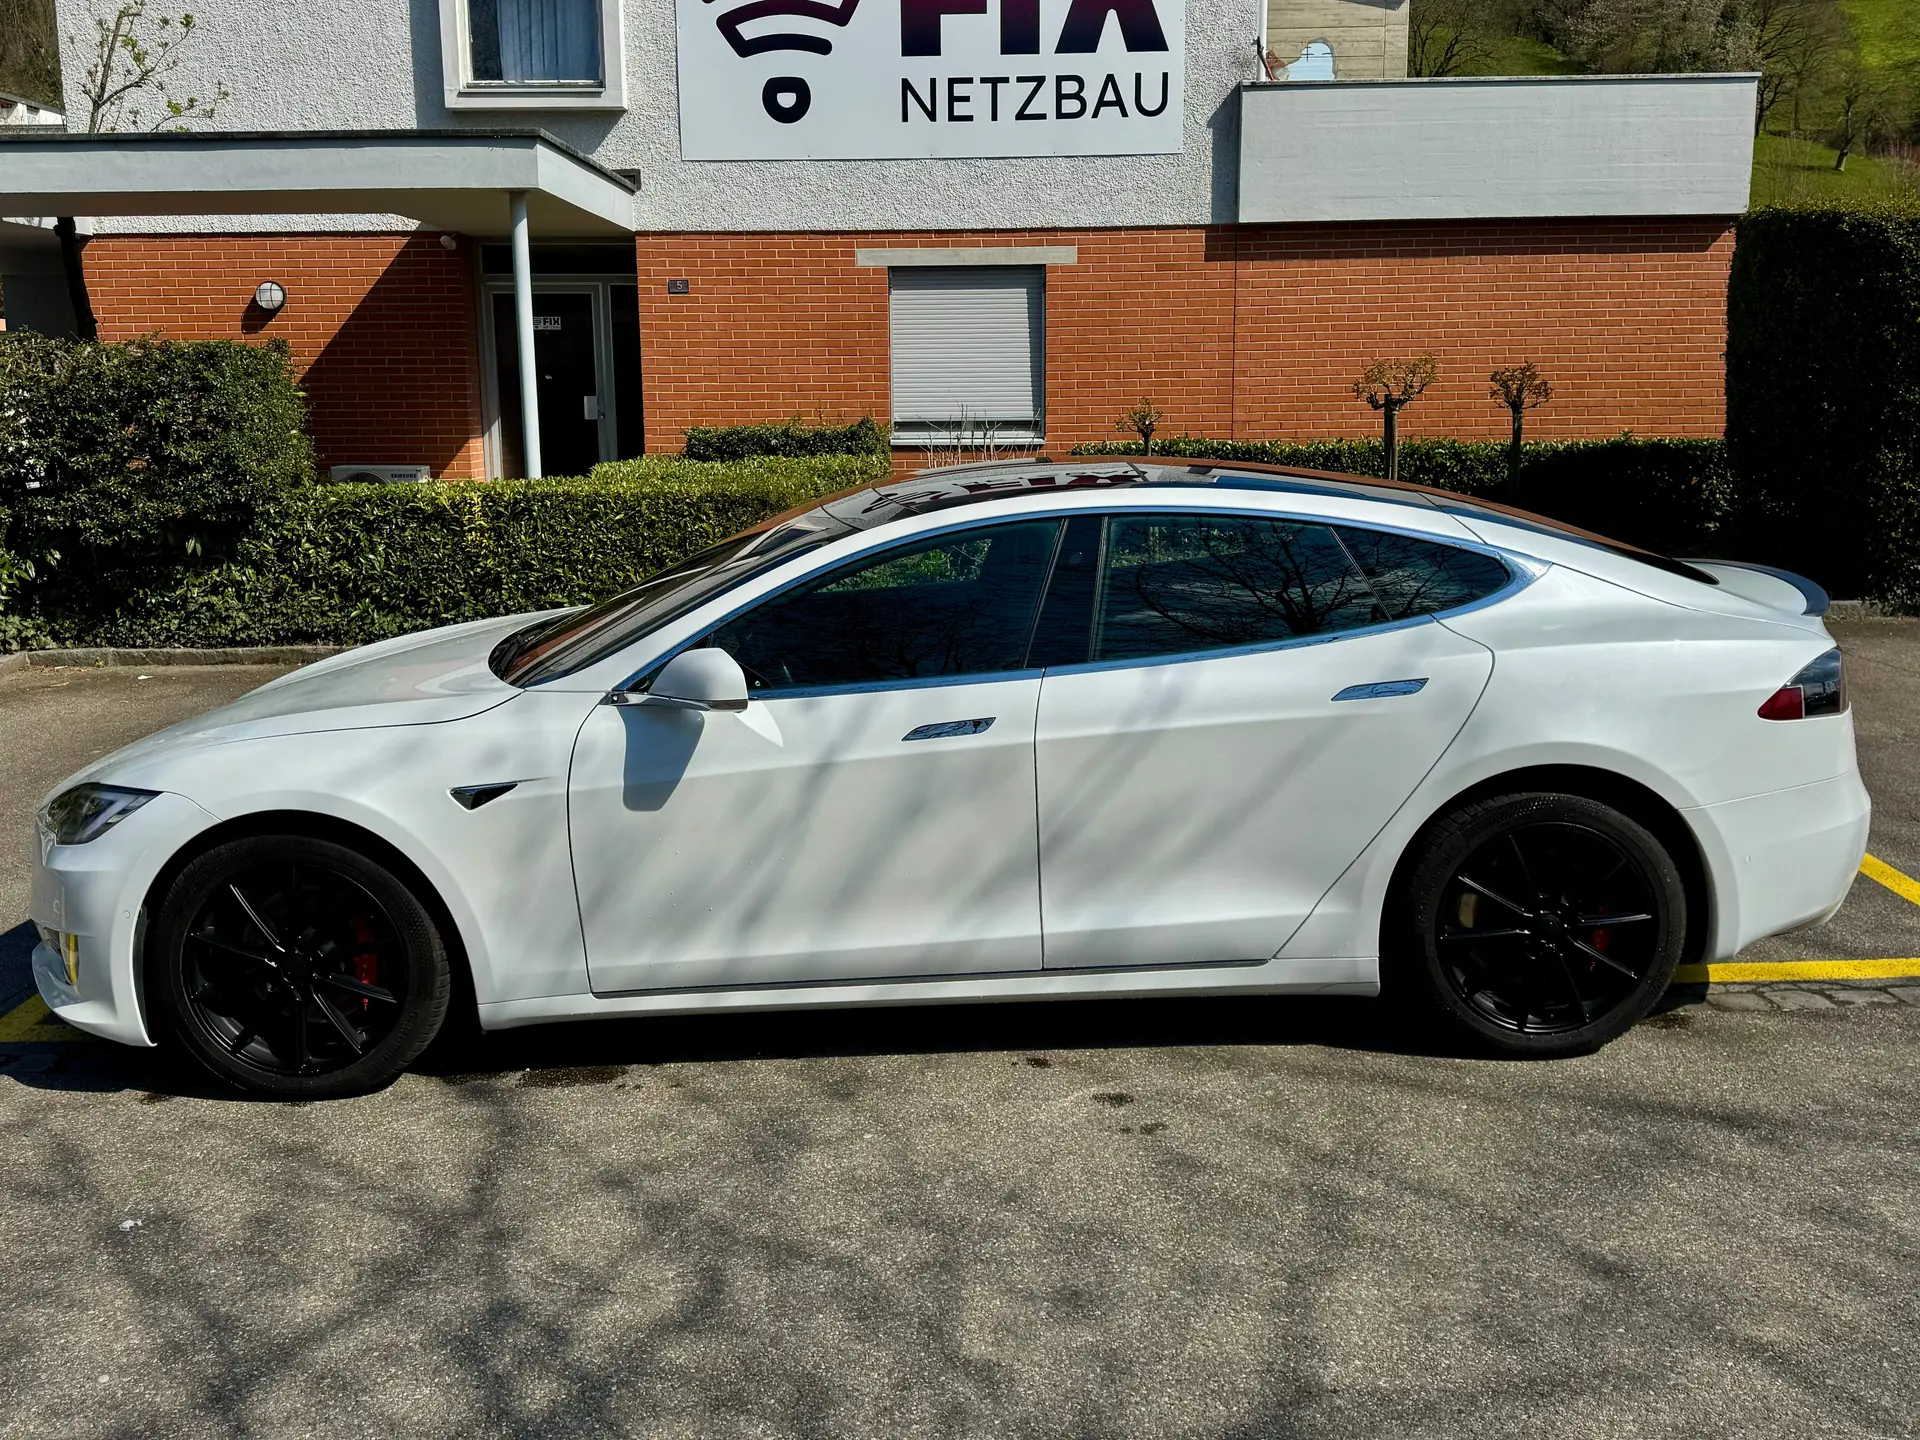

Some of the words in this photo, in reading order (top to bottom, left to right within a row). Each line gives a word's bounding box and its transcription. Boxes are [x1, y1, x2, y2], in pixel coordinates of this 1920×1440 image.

[901, 72, 1169, 123] NETZBAU
[676, 280, 683, 290] 5
[543, 317, 560, 326] FIX
